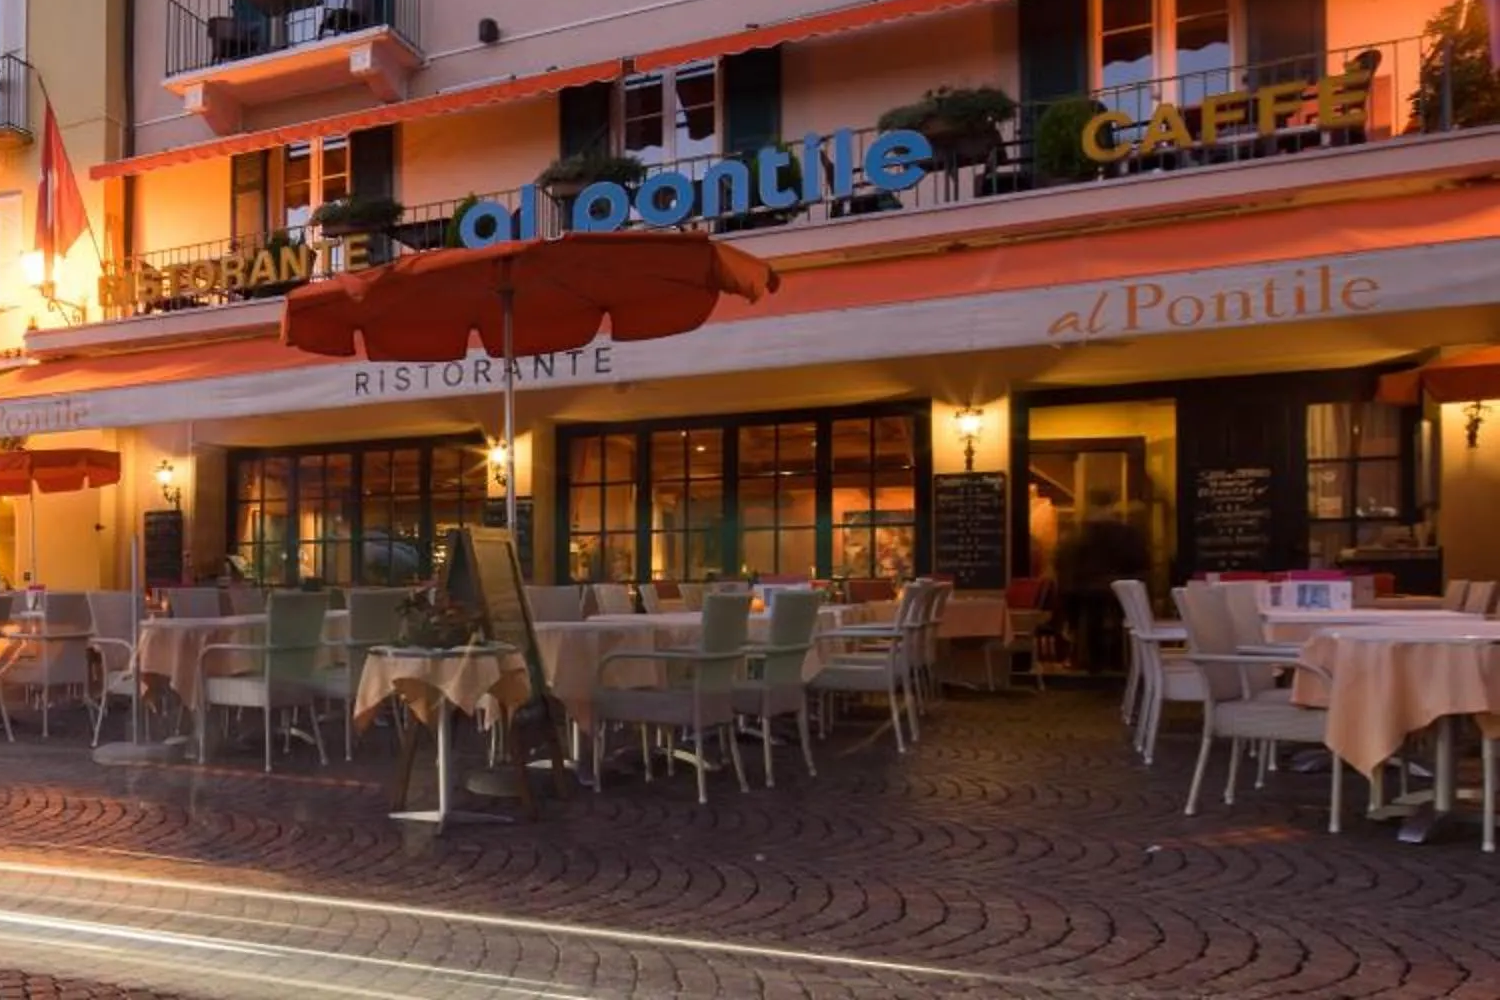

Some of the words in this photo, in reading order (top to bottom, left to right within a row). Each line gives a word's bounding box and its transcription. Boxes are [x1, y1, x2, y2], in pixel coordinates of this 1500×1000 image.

[459, 183, 537, 248] al
[572, 127, 933, 233] pontile
[98, 231, 373, 306] RISTORANTE
[1047, 291, 1110, 336] al
[1121, 264, 1383, 332] Pontile
[354, 346, 613, 397] RISTORANTE
